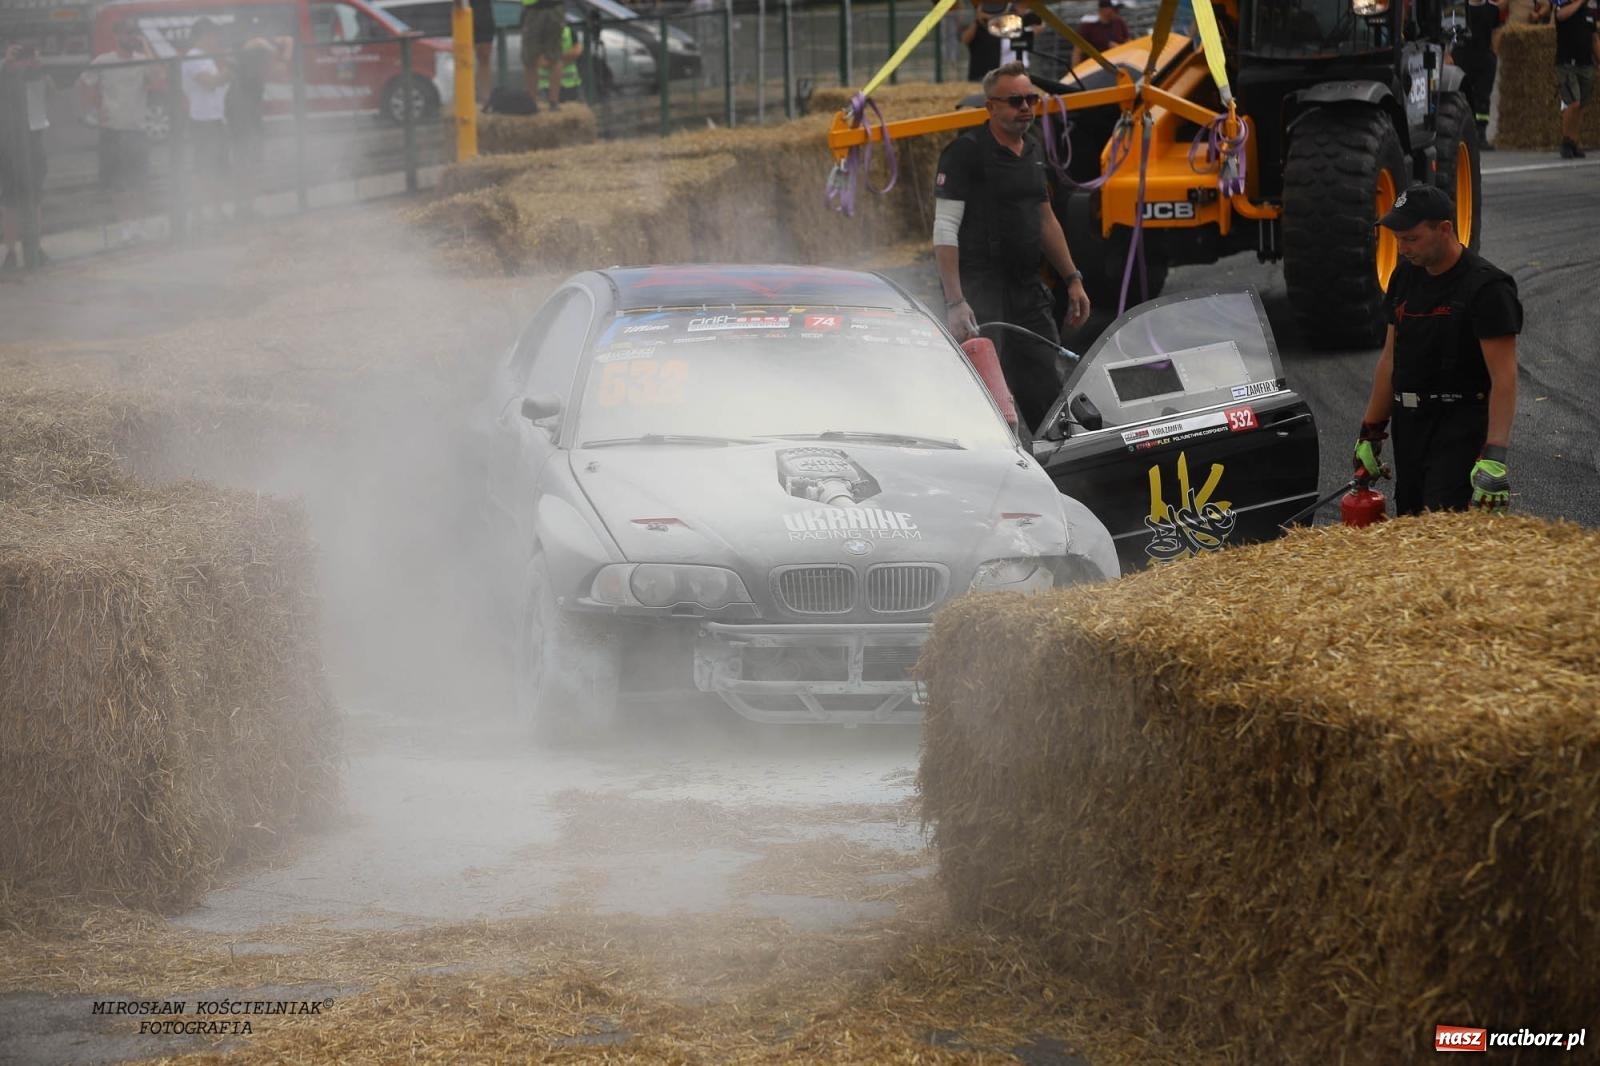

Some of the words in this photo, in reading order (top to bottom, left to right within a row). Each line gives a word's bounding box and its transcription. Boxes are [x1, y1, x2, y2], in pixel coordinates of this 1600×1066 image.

[1411, 77, 1426, 104] JCB
[1141, 202, 1194, 219] JCB
[810, 317, 834, 326] 74
[1245, 382, 1271, 397] ZAMFIR
[1229, 410, 1254, 429] 532
[787, 529, 864, 543] RACING
[866, 529, 922, 541] TEAM
